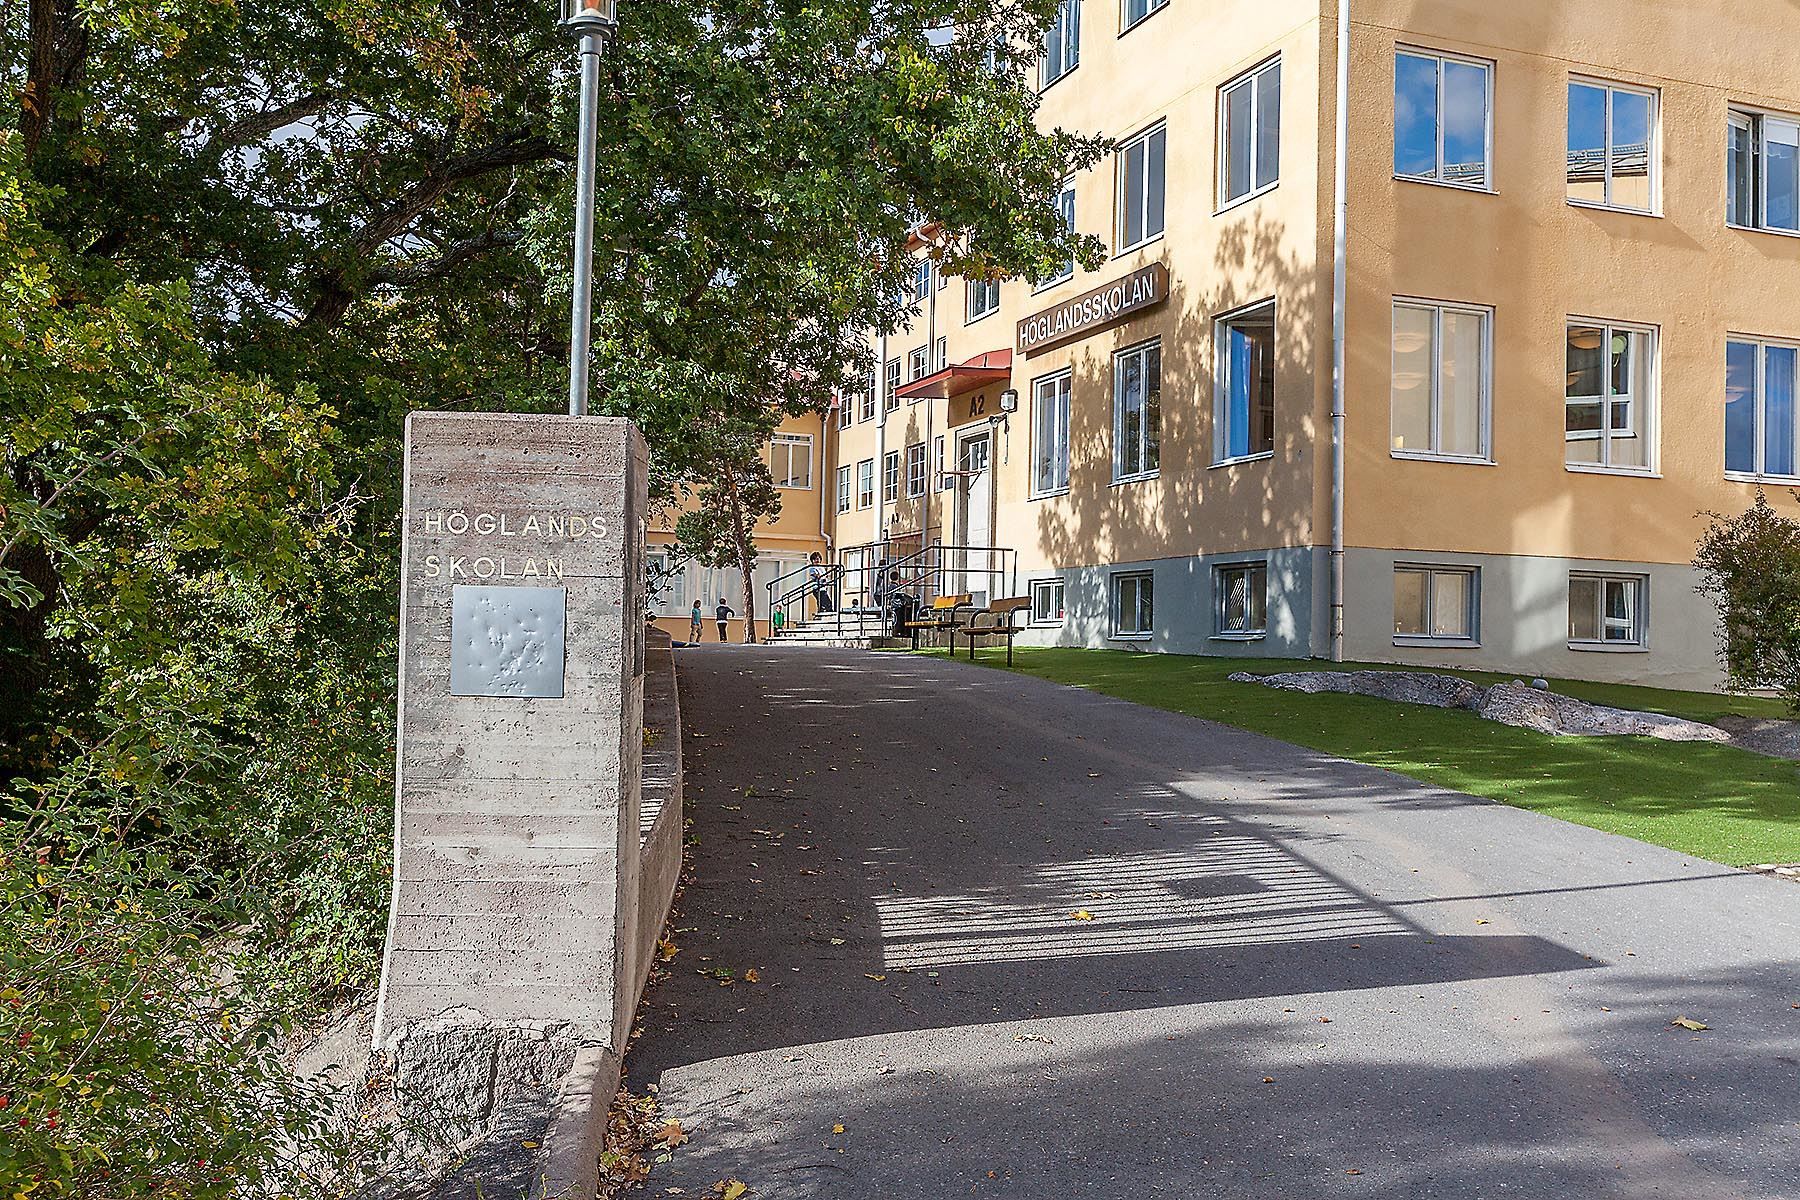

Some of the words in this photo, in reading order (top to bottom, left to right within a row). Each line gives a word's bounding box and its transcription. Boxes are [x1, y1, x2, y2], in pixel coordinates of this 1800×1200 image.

[1019, 272, 1154, 349] HÖGLANDSSKOLAN
[969, 394, 985, 418] A2
[424, 510, 608, 539] HÖGLANDS
[424, 555, 564, 580] SKOLAN
